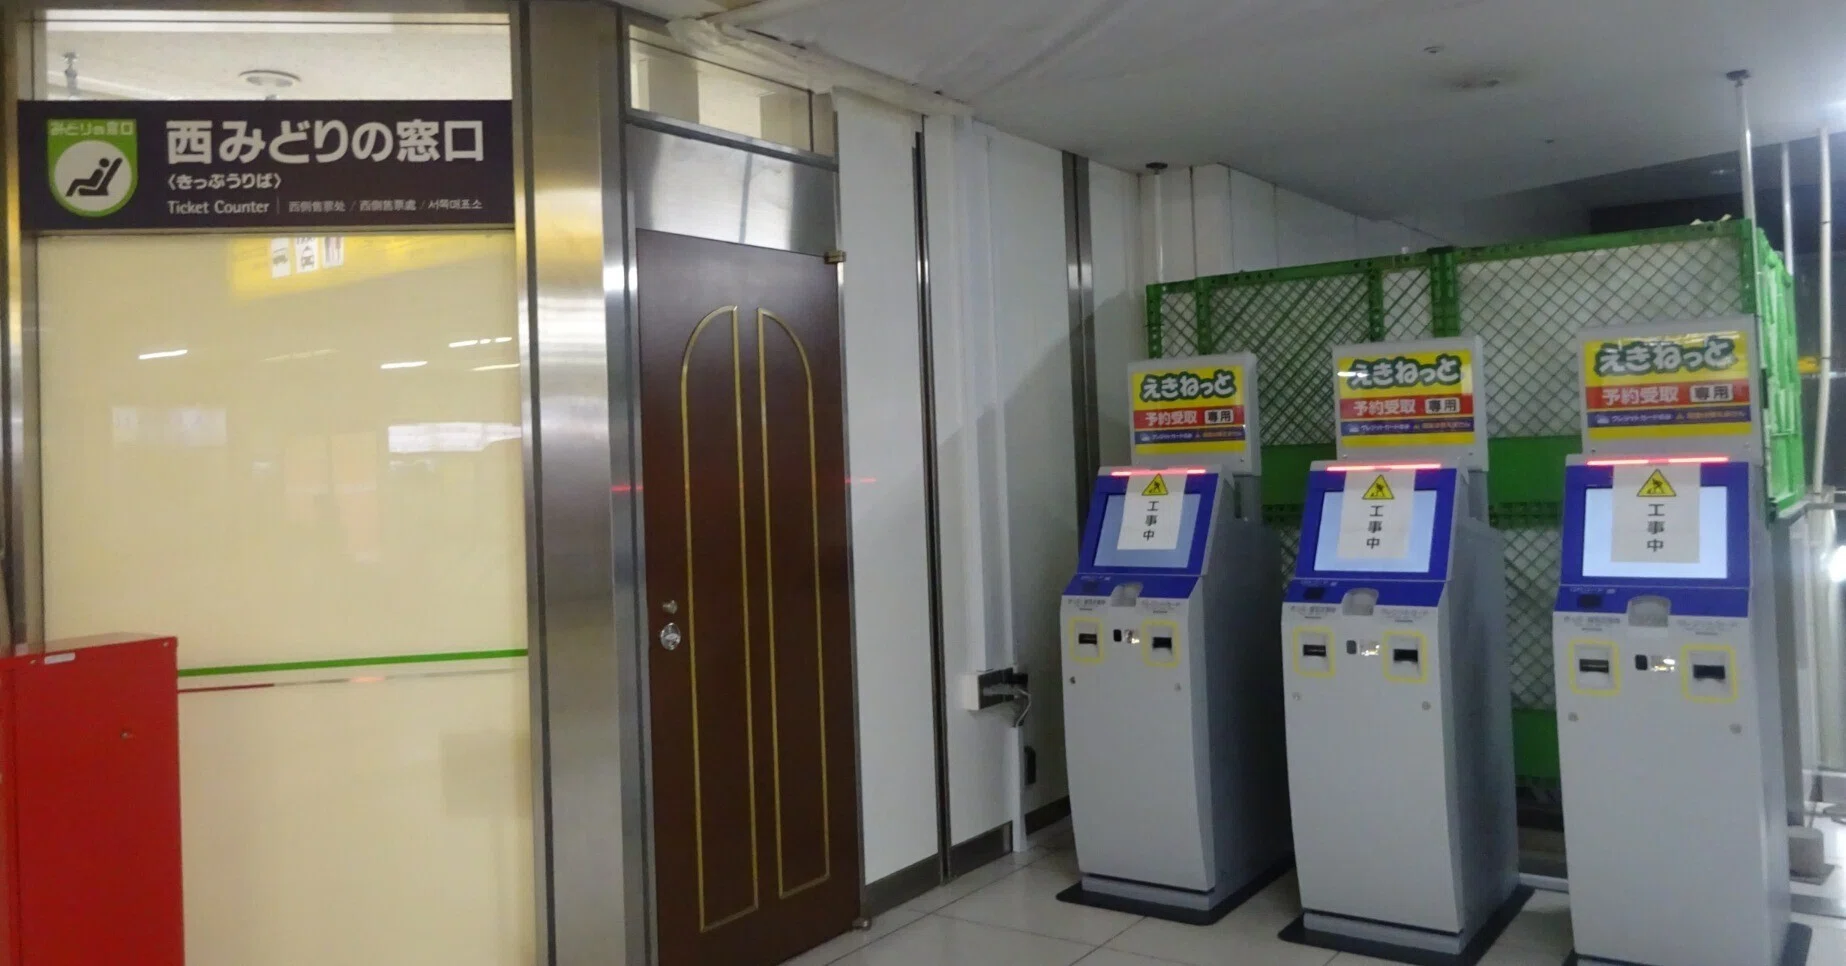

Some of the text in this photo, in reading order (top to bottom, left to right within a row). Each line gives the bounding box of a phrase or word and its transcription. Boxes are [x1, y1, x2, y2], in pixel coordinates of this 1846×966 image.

[166, 119, 484, 164] 西みどりの窓口
[167, 200, 270, 215] Ticket Counter
[1349, 355, 1461, 388] えきねっと
[1596, 338, 1735, 374] えきねっと
[1141, 371, 1235, 401] えきねっと
[1602, 386, 1730, 406] 予約受取 専用
[1145, 410, 1232, 427] 予約受取 専用
[1353, 398, 1457, 417] 予約受取 専用
[1143, 500, 1160, 541] 工事中
[1366, 504, 1384, 550] 工事中
[1647, 503, 1666, 552] 工事中
